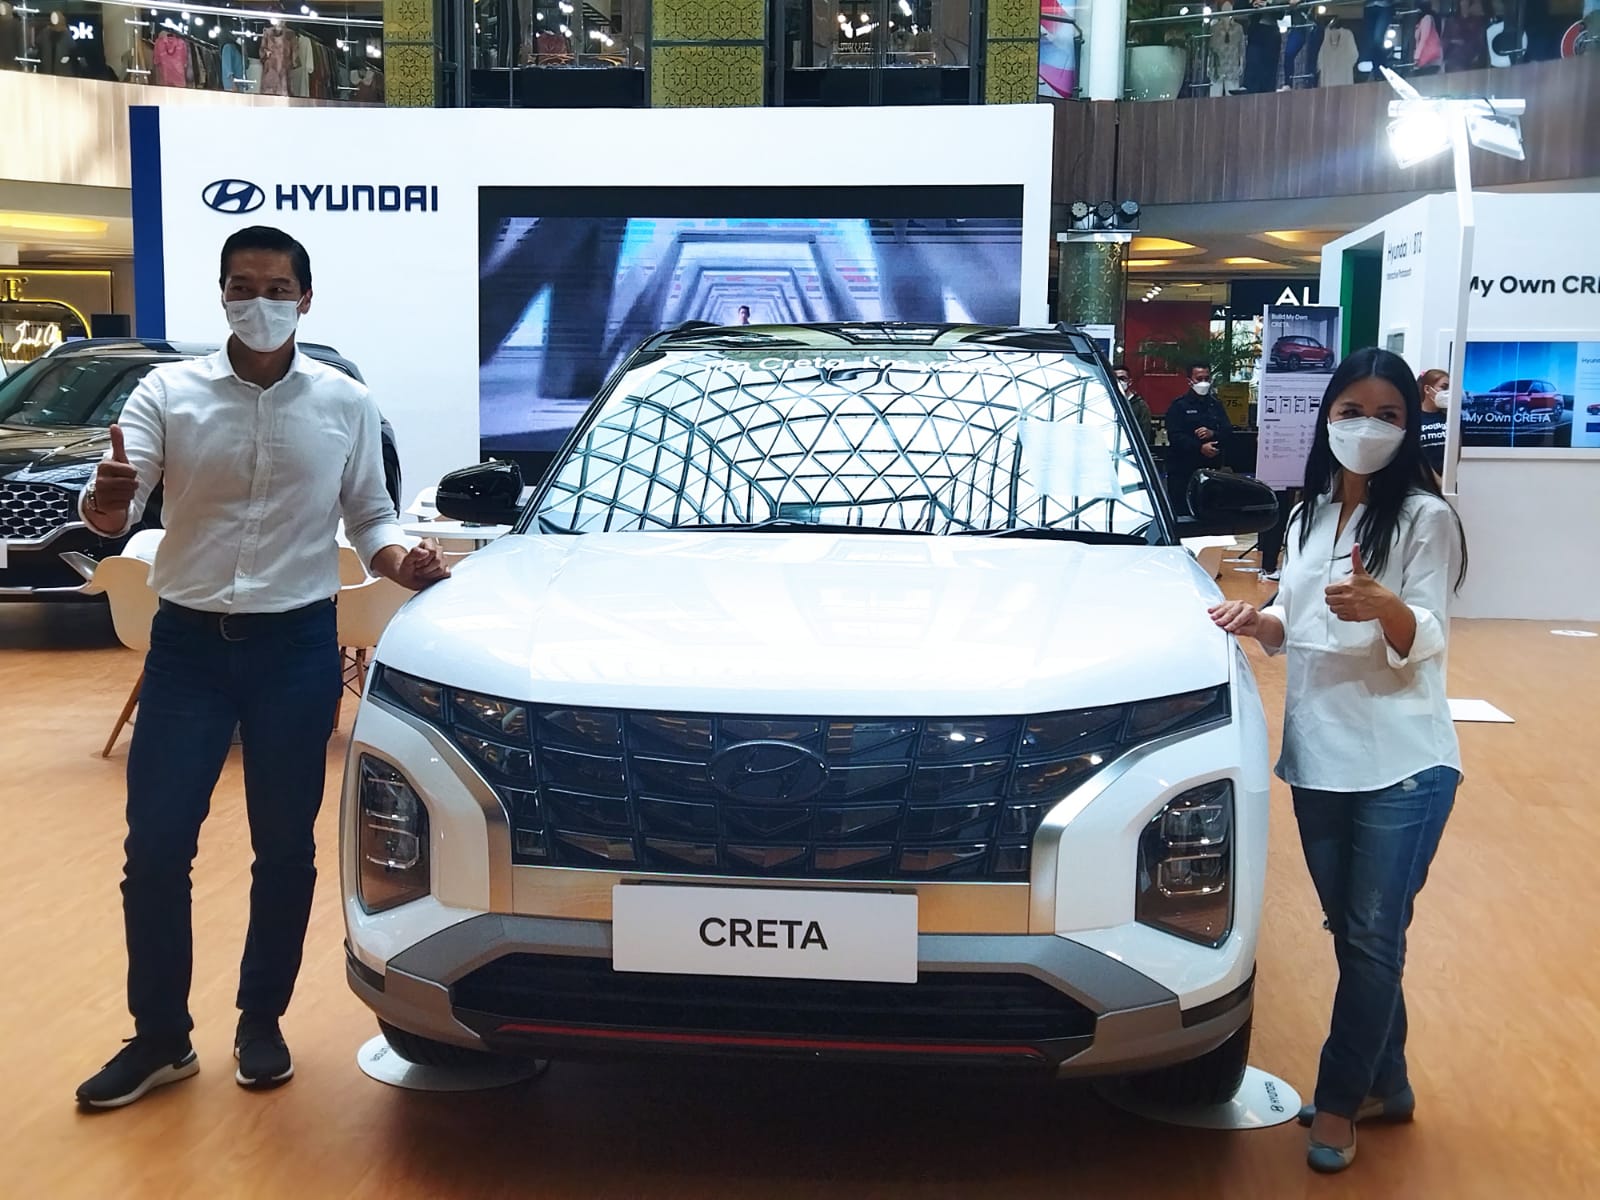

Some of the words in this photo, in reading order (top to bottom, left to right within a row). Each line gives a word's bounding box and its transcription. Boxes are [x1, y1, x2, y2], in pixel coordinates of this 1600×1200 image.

[276, 184, 438, 212] HYUNDAI
[1500, 276, 1555, 294] Own
[1562, 276, 1600, 294] CR
[1485, 412, 1511, 423] Own
[1514, 412, 1551, 423] CRETA
[699, 917, 828, 950] CRETA
